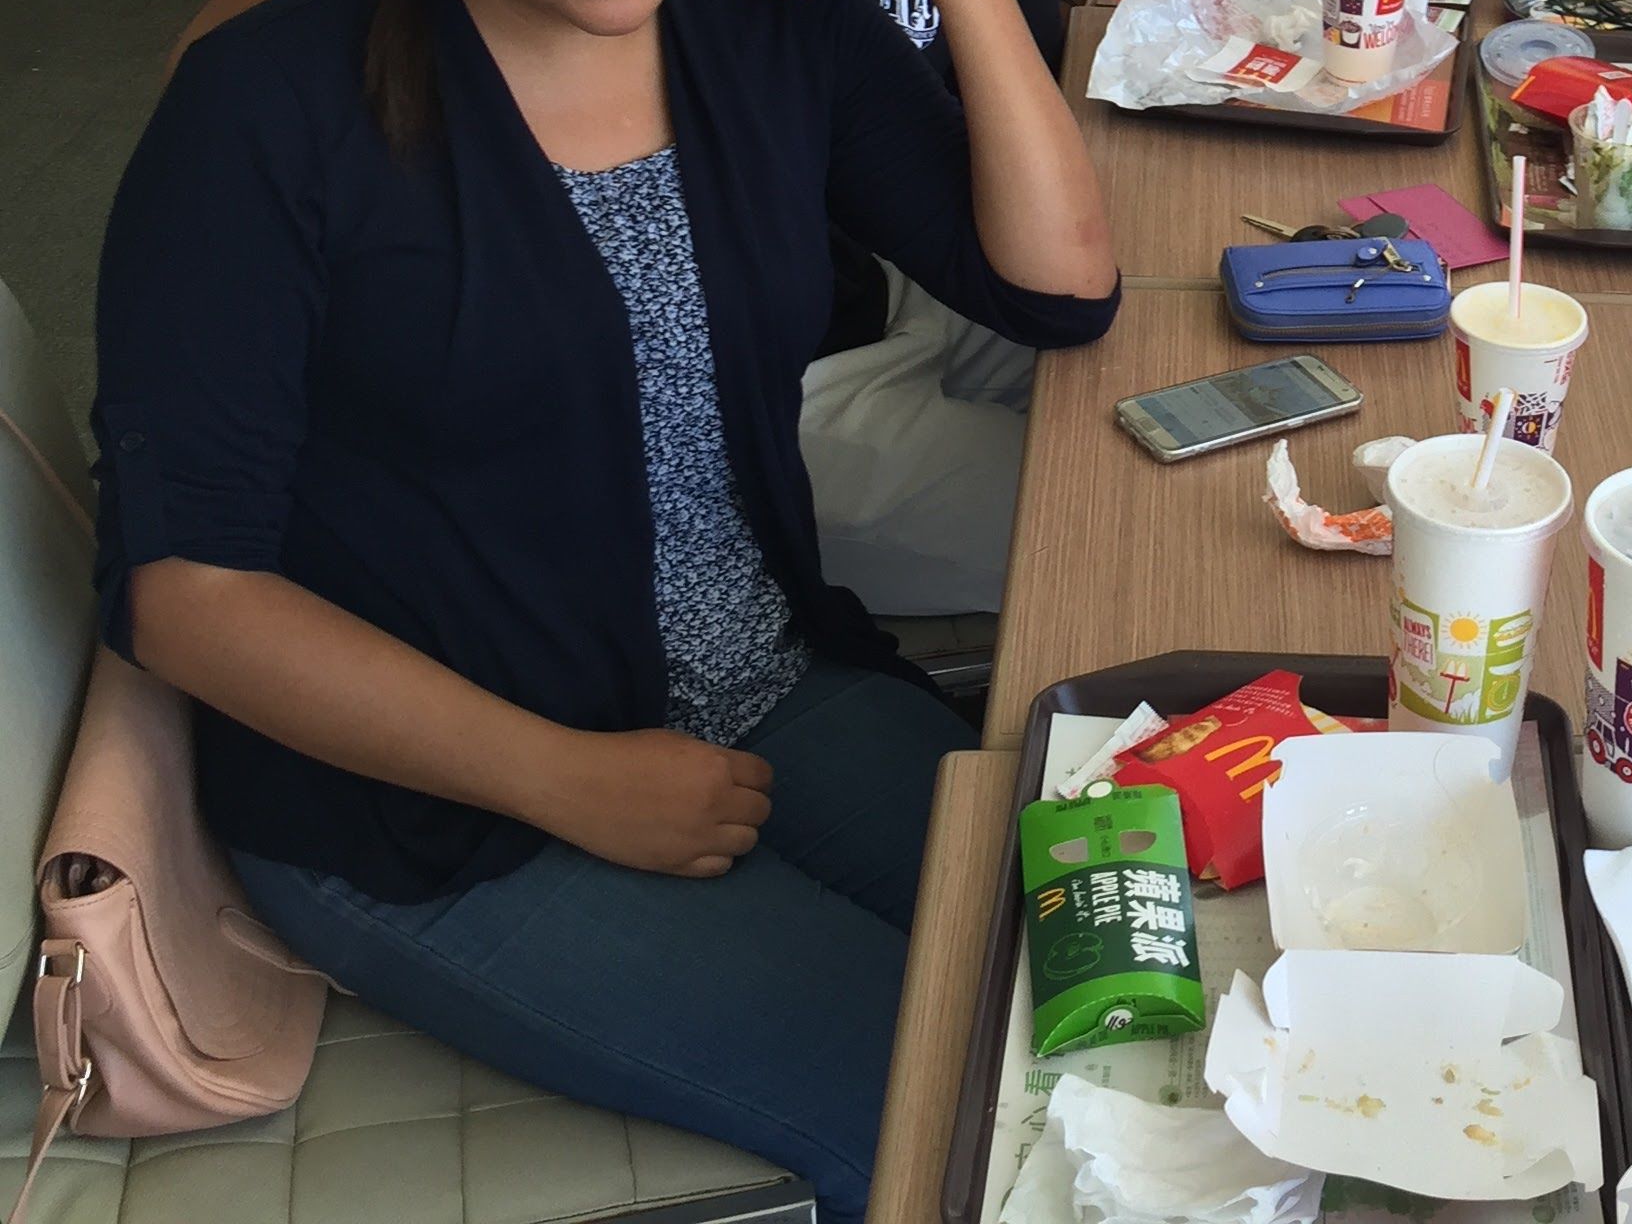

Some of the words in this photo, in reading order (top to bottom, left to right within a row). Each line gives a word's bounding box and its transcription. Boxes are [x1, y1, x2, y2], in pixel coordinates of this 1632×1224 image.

[1090, 871, 1120, 906] APPLE
[1094, 905, 1122, 927] PIE
[1122, 868, 1190, 968] 蘋果派
